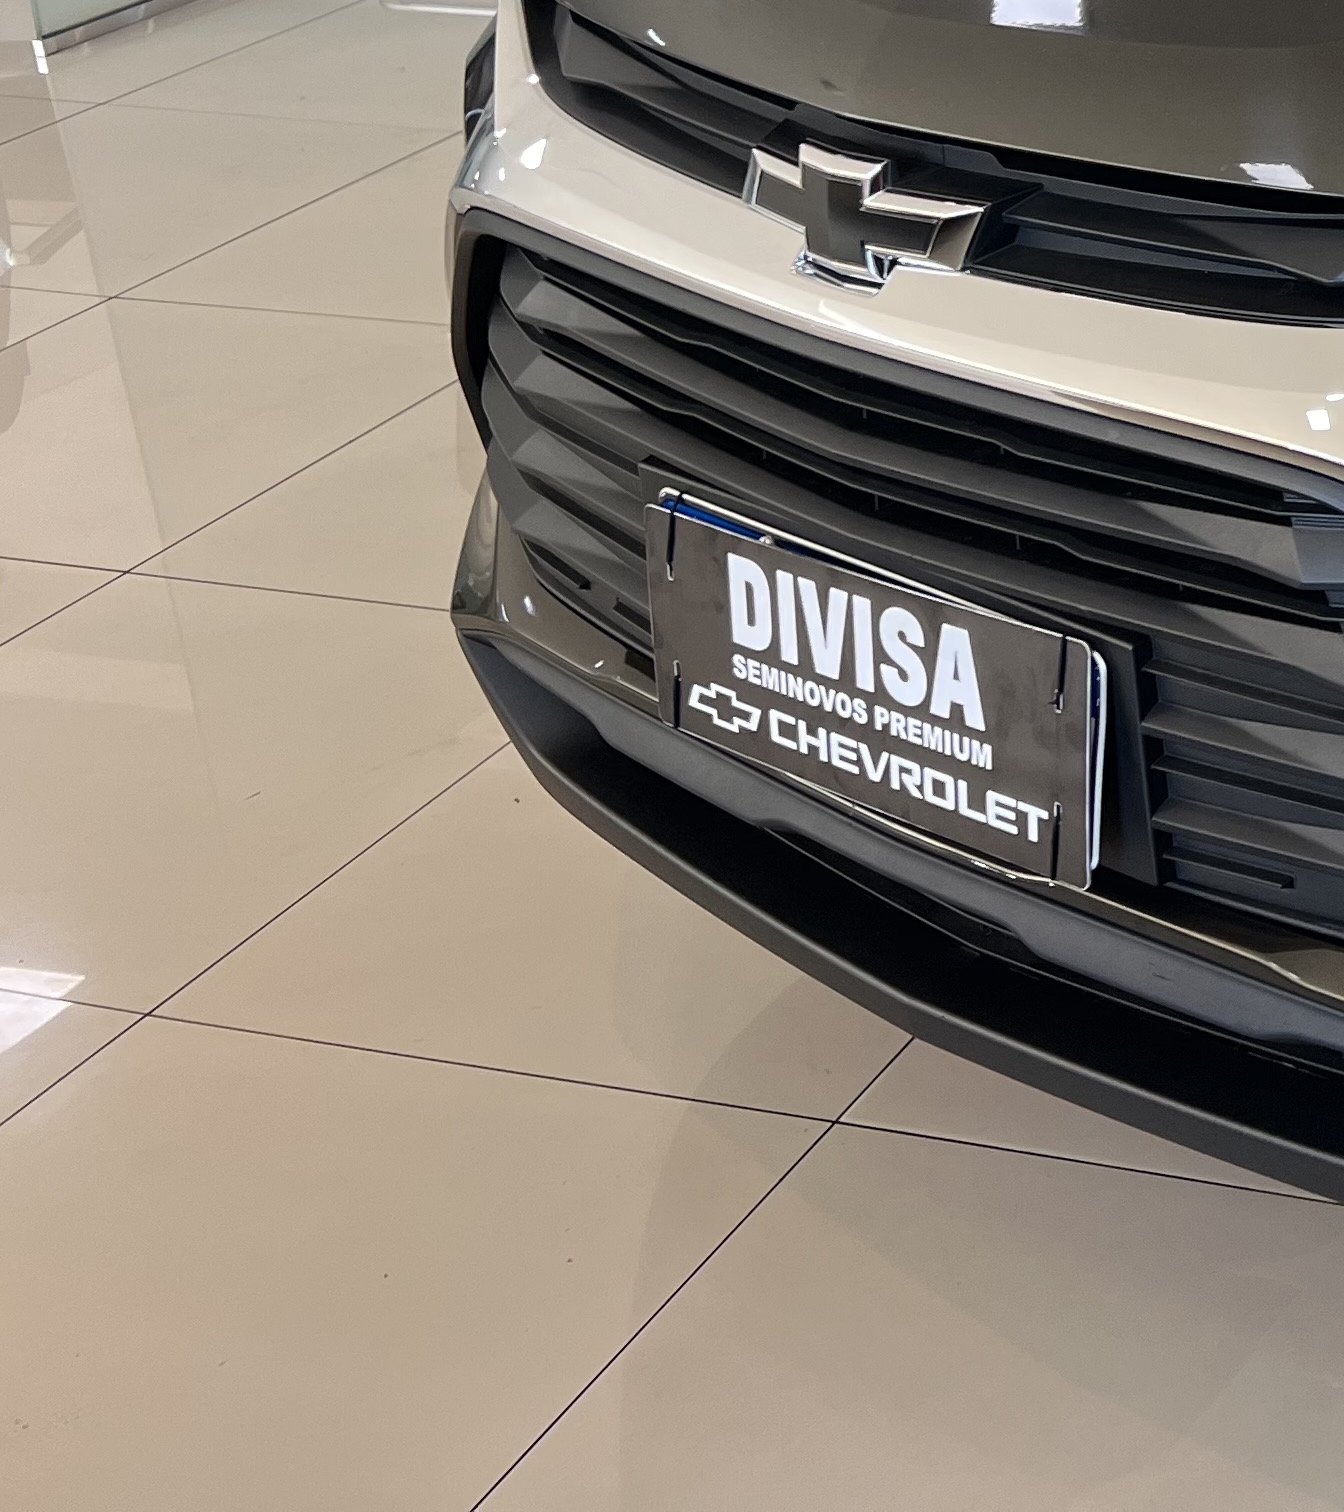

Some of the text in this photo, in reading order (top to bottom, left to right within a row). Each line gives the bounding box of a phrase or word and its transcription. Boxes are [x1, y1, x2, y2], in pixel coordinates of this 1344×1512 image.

[726, 551, 986, 732] DIVISA
[731, 652, 994, 771] SEMINOVOS PREMIUM
[768, 708, 1050, 844] CHEVROLET
